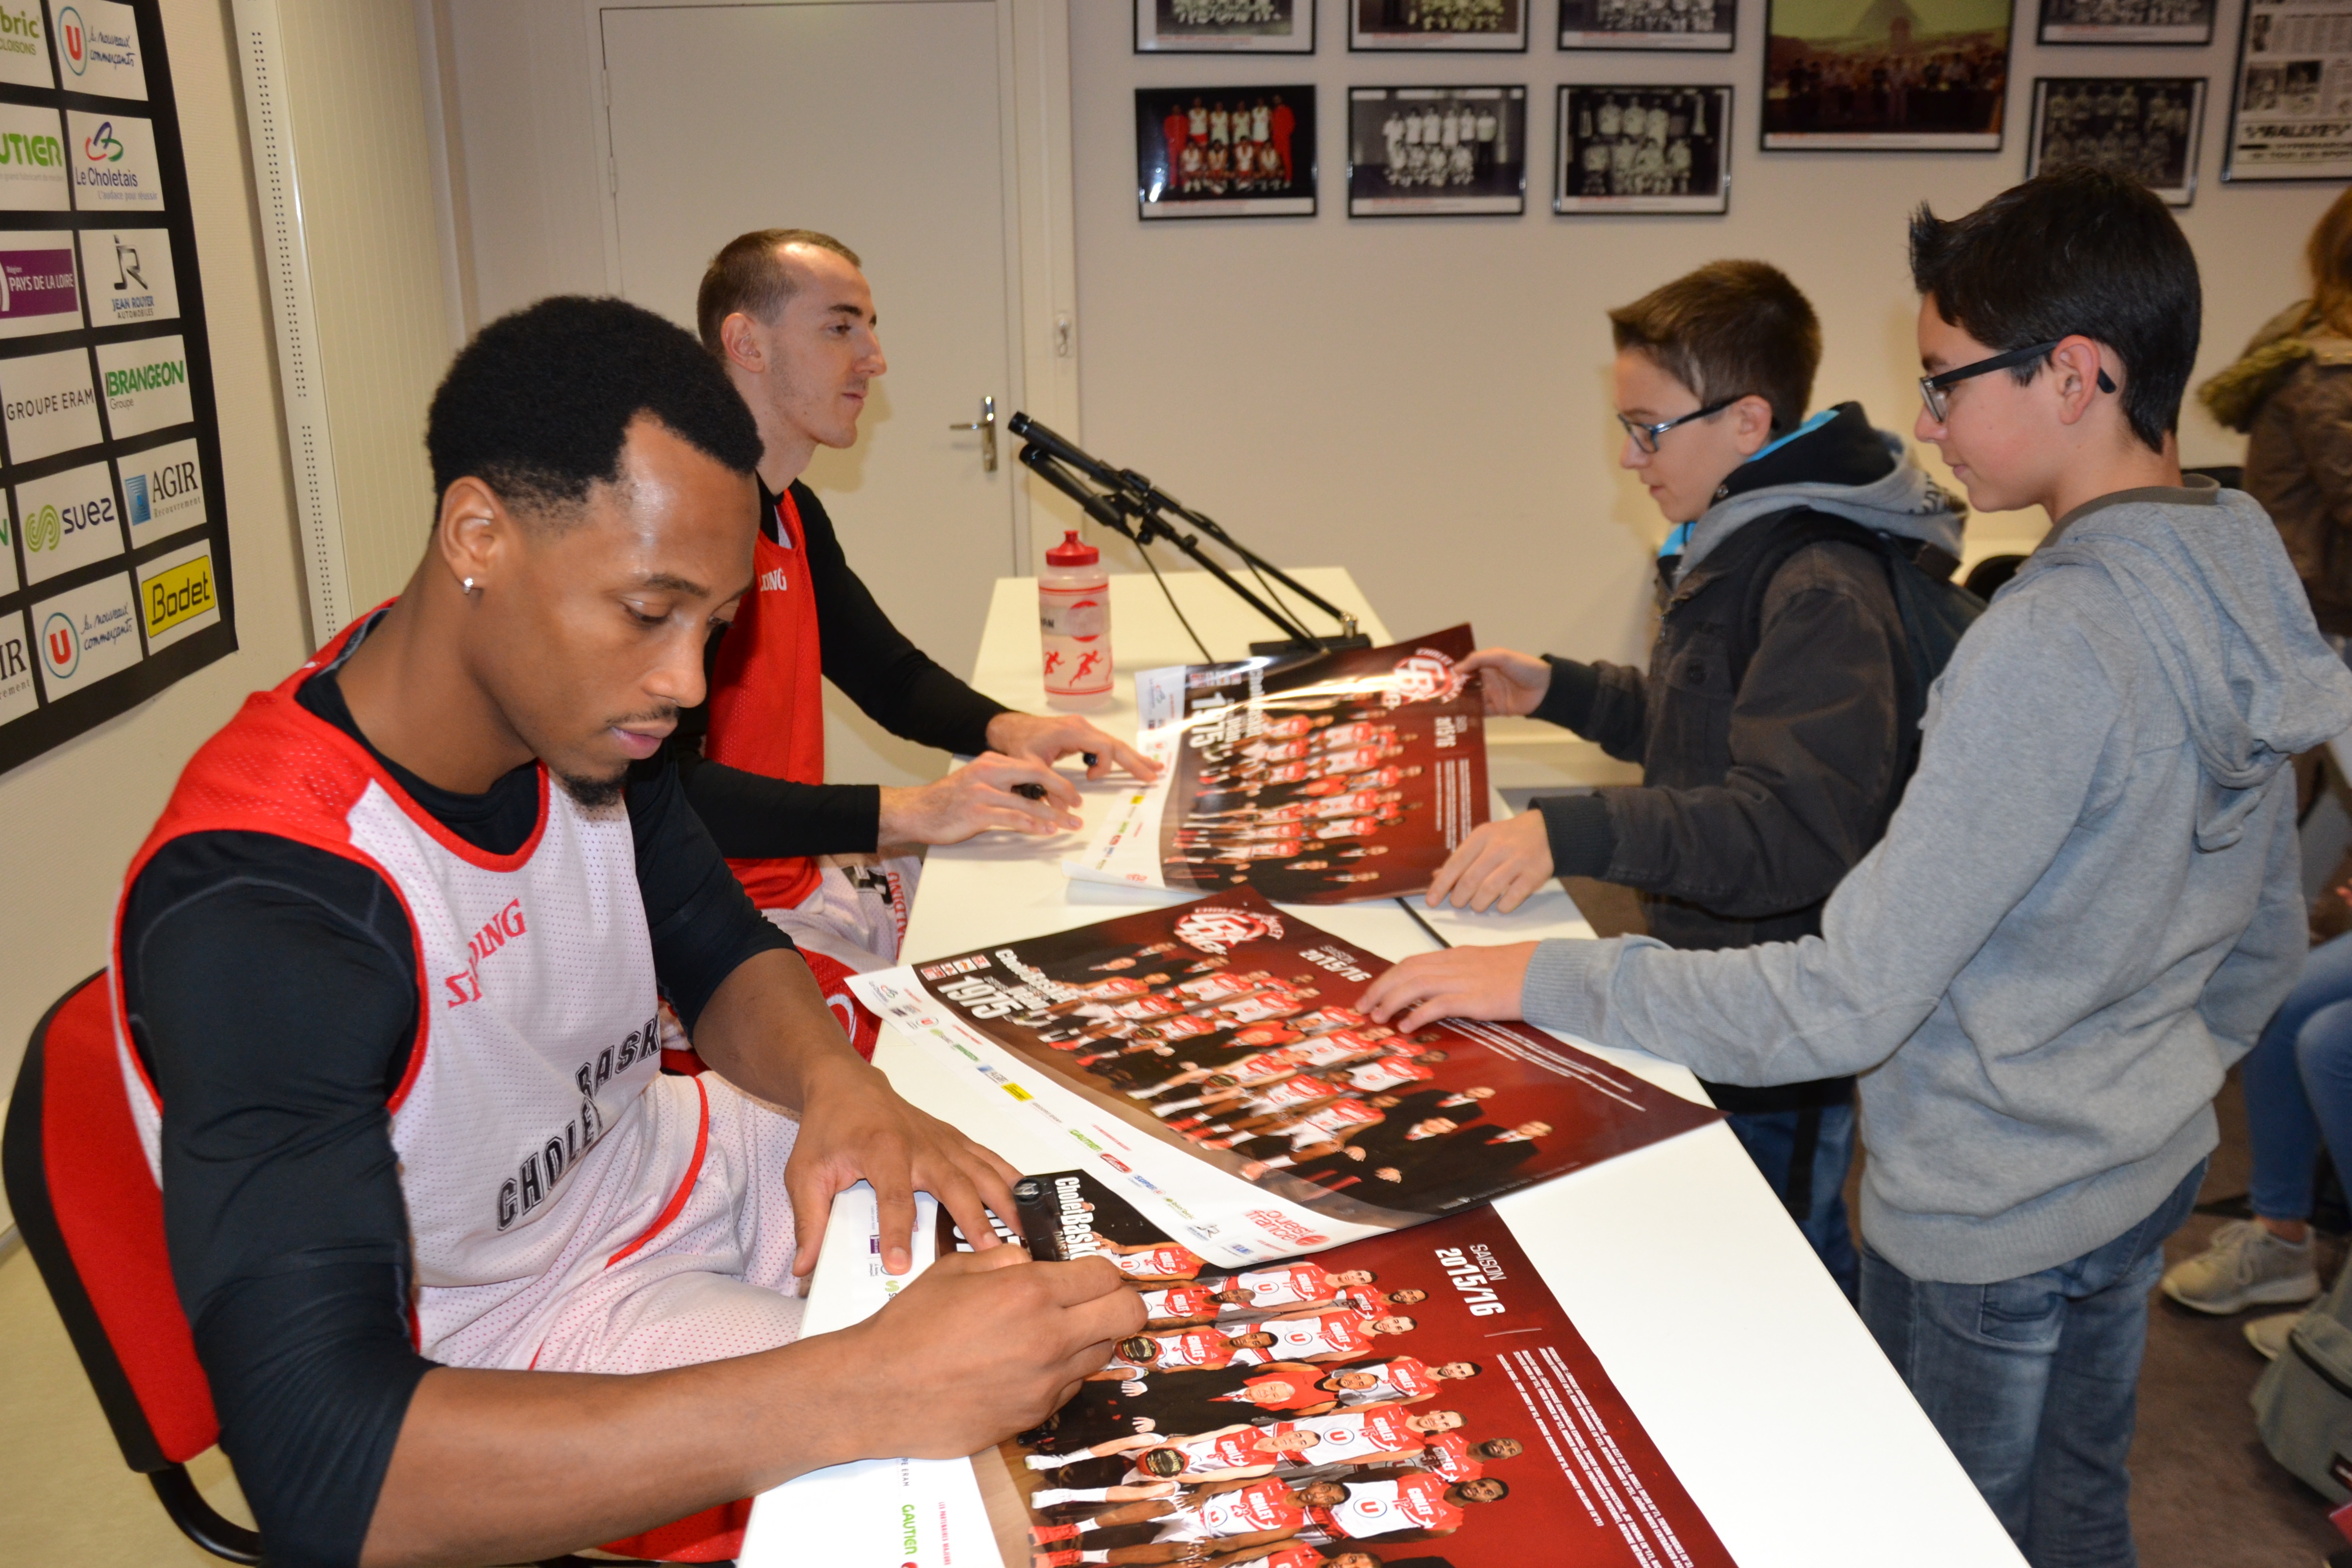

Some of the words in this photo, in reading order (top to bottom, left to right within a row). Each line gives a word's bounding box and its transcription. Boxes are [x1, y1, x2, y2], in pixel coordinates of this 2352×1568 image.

[66, 26, 82, 61] U
[97, 32, 131, 48] nouveaux
[90, 50, 136, 71] commerçants
[76, 167, 87, 186] Le
[88, 167, 138, 187] Choletais
[9, 276, 33, 292] PAYS
[34, 276, 45, 290] DE
[45, 275, 55, 289] LA
[55, 273, 75, 289] LOIRE
[111, 298, 130, 312] JEAN
[117, 308, 154, 320] AUTOMOBILES
[105, 360, 184, 398] BRANGEON
[6, 395, 58, 421] GROUPE
[62, 388, 94, 409] ERAM
[110, 398, 134, 410] Groupe
[153, 461, 199, 503] AGIR
[154, 496, 201, 519] Recouvrement
[152, 571, 211, 626] Bodet
[93, 602, 129, 626] nouveaux
[50, 628, 72, 665] U
[84, 618, 133, 651] commerçants
[1299, 949, 1373, 983] 2015/16
[937, 974, 1024, 1020] 1975
[1245, 1209, 1297, 1242] france
[1266, 1209, 1316, 1238] ouest
[1469, 1242, 1508, 1282] SAISON
[1295, 1273, 1315, 1293] CHOLET
[1435, 1246, 1506, 1317] 2015/16
[1353, 1293, 1374, 1311] CHOLET
[1329, 1321, 1352, 1343] CHOLET
[1186, 1335, 1206, 1358] CHOLET
[1393, 1368, 1417, 1389] CHOLET
[1372, 1416, 1397, 1441] CHOLET
[1432, 1446, 1458, 1472] CHOLET
[901, 1468, 910, 1486] ERAM
[1230, 1502, 1253, 1518] 23
[1248, 1491, 1276, 1521] CHOLET
[1392, 1497, 1413, 1511] 12
[1407, 1487, 1434, 1516] CHOLET
[901, 1504, 918, 1555] GAUTIER
[939, 1510, 949, 1541] PARTENAIRES
[942, 1542, 951, 1565] MAJEURS
